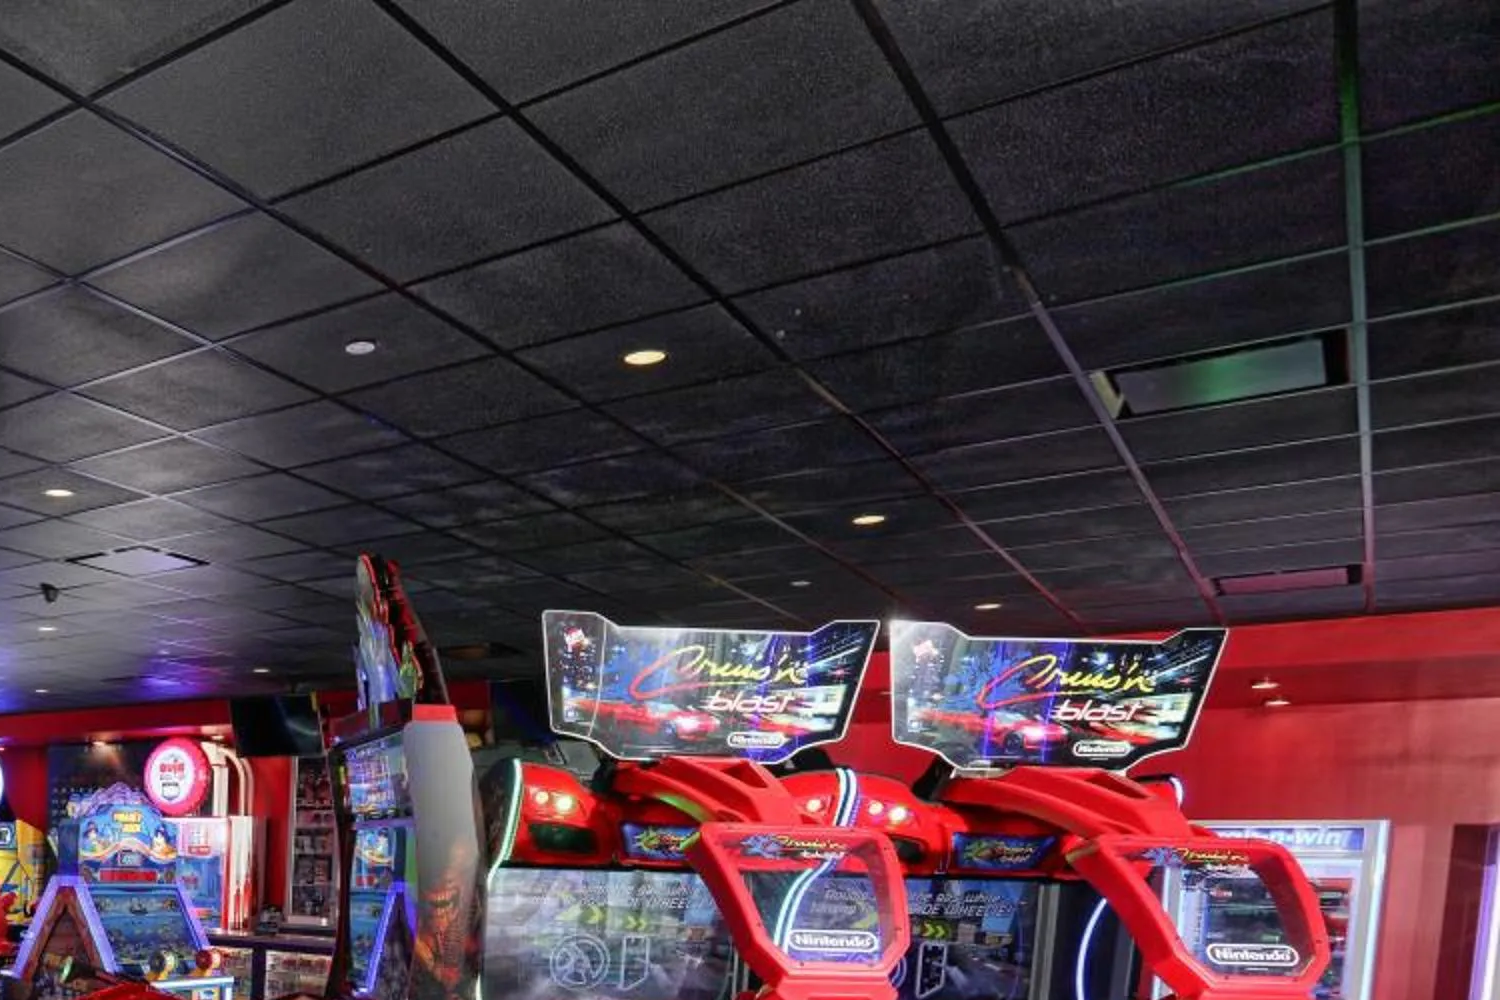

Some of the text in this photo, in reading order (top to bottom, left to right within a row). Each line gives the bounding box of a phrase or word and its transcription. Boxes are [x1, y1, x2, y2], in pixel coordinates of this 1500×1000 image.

[629, 645, 808, 701] Cruis'n
[975, 653, 1156, 709] Cruis'n
[1056, 699, 1142, 721] blast
[794, 933, 872, 947] Nintendo
[1215, 947, 1291, 962] Nintendo
